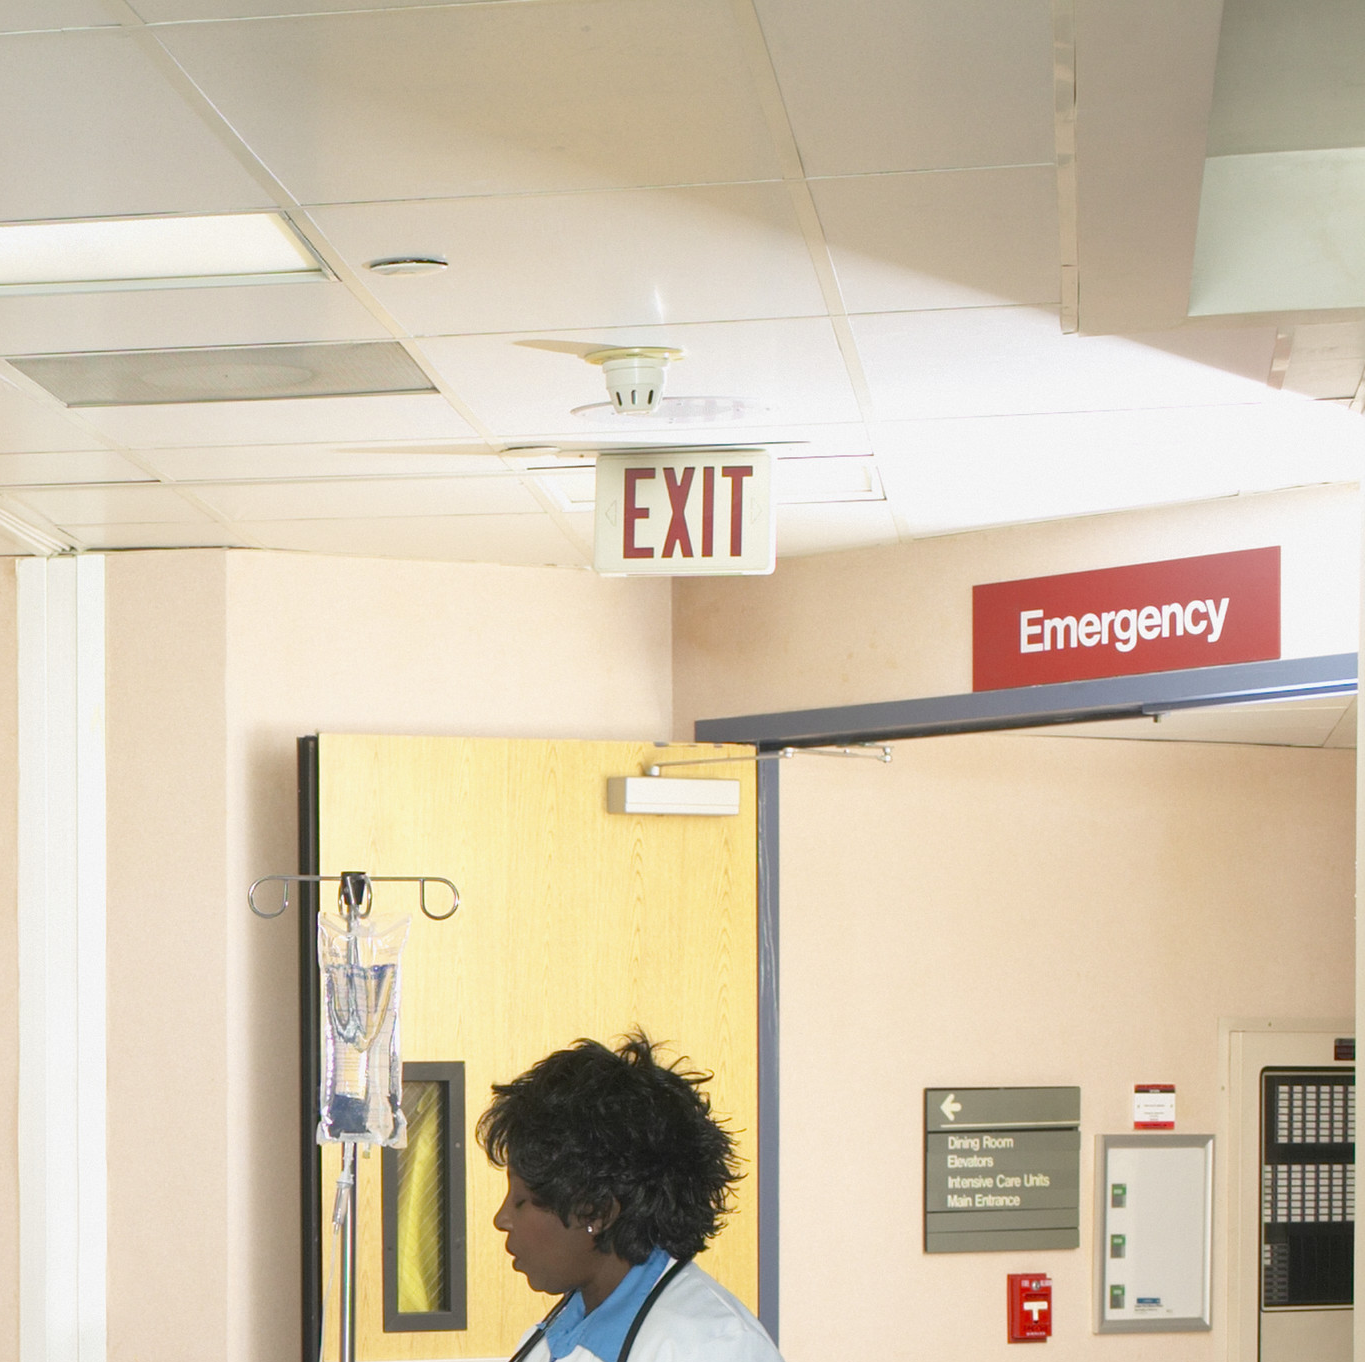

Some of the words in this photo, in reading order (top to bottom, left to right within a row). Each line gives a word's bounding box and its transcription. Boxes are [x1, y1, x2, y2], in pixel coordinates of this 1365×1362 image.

[623, 465, 753, 559] EXIT
[1020, 597, 1230, 653] Emergency
[947, 1136, 980, 1151] Dining
[982, 1135, 1014, 1149] Room
[947, 1155, 994, 1168] Elevators
[947, 1176, 994, 1189] Intensive
[996, 1174, 1021, 1188] Care
[1023, 1173, 1051, 1187] Units
[947, 1194, 972, 1208] Main
[974, 1194, 1021, 1207] Entrance
